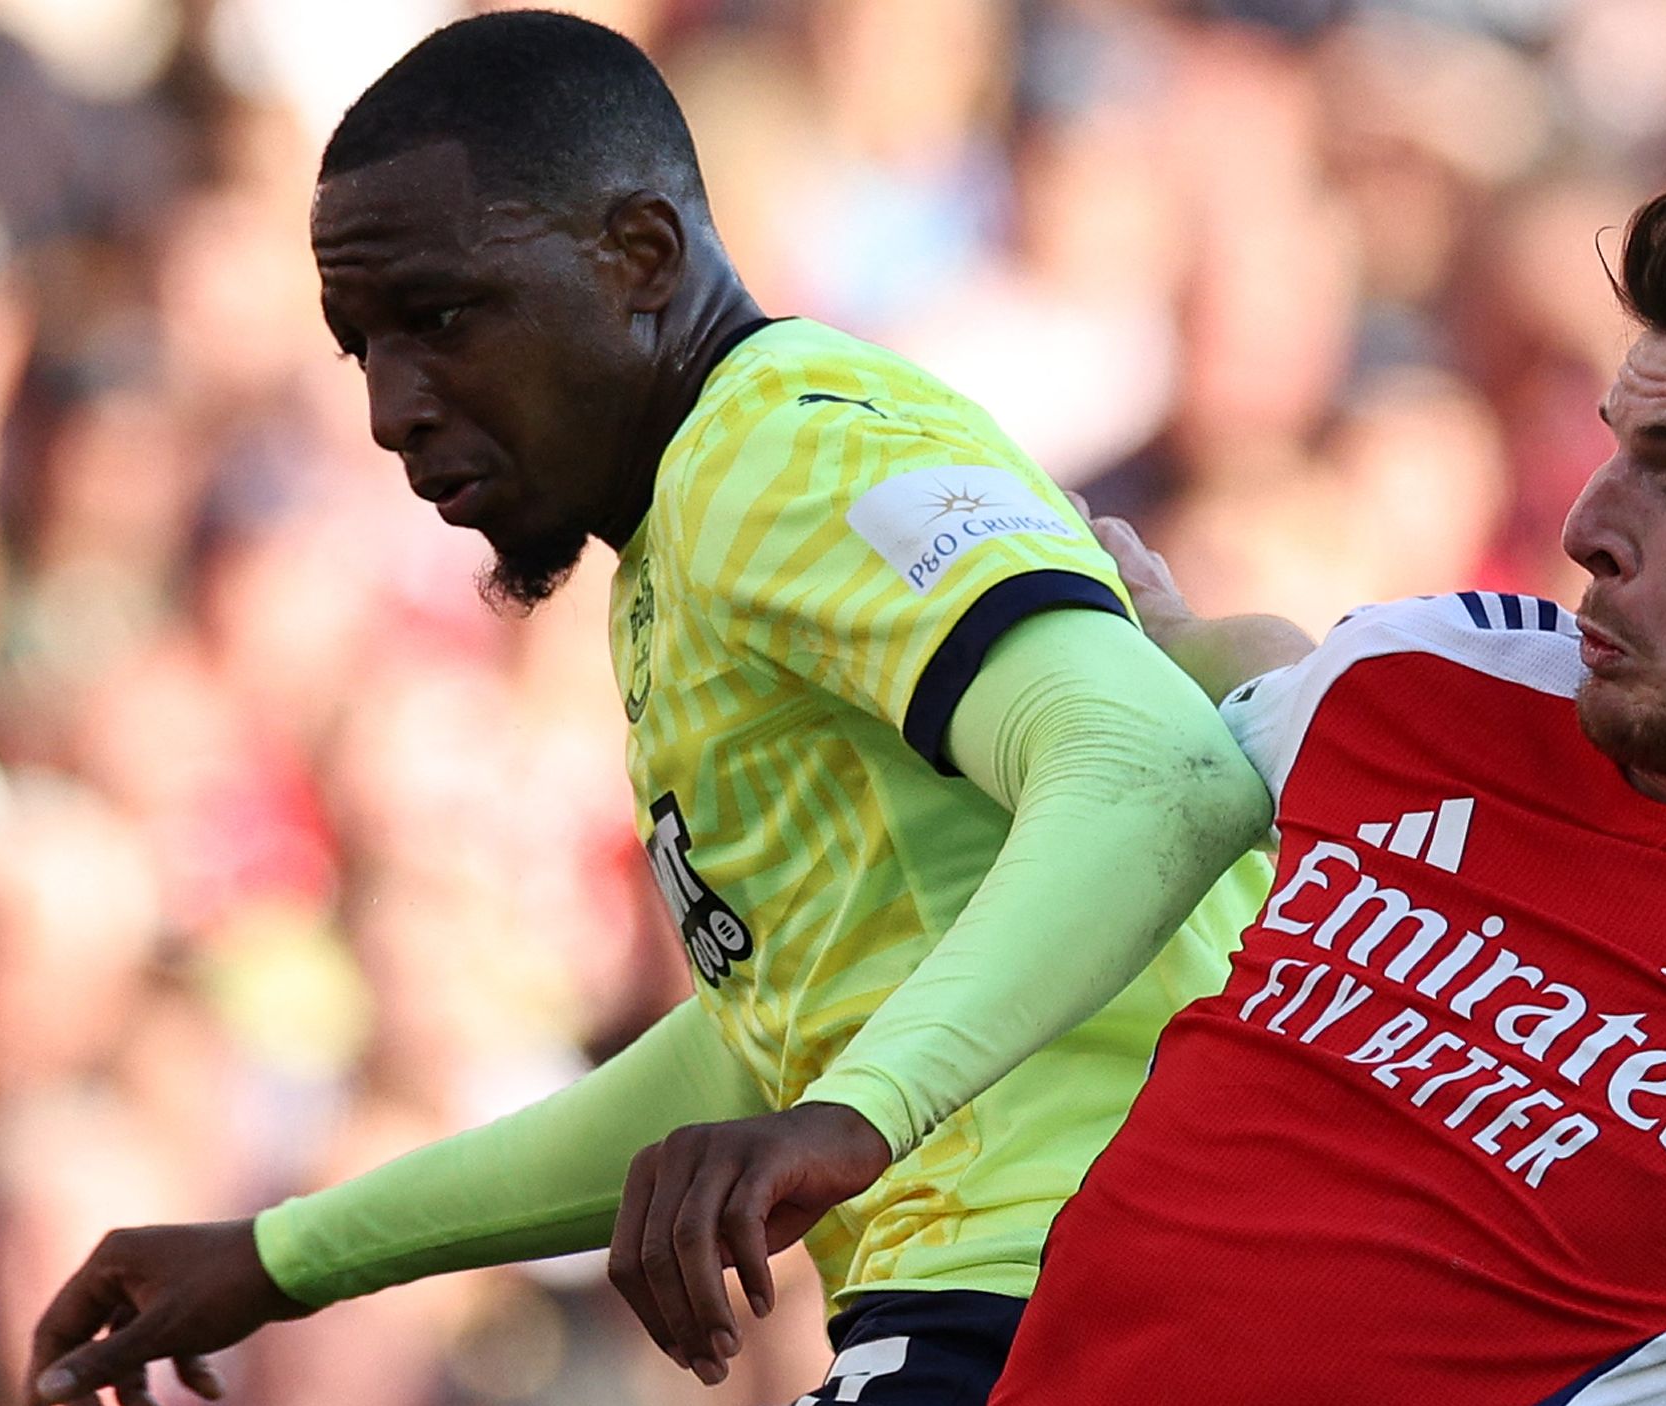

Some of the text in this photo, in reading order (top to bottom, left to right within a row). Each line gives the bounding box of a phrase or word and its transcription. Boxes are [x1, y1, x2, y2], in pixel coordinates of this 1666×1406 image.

[909, 523, 958, 589] P&O
[1238, 958, 1601, 1189] FLY BETTER
